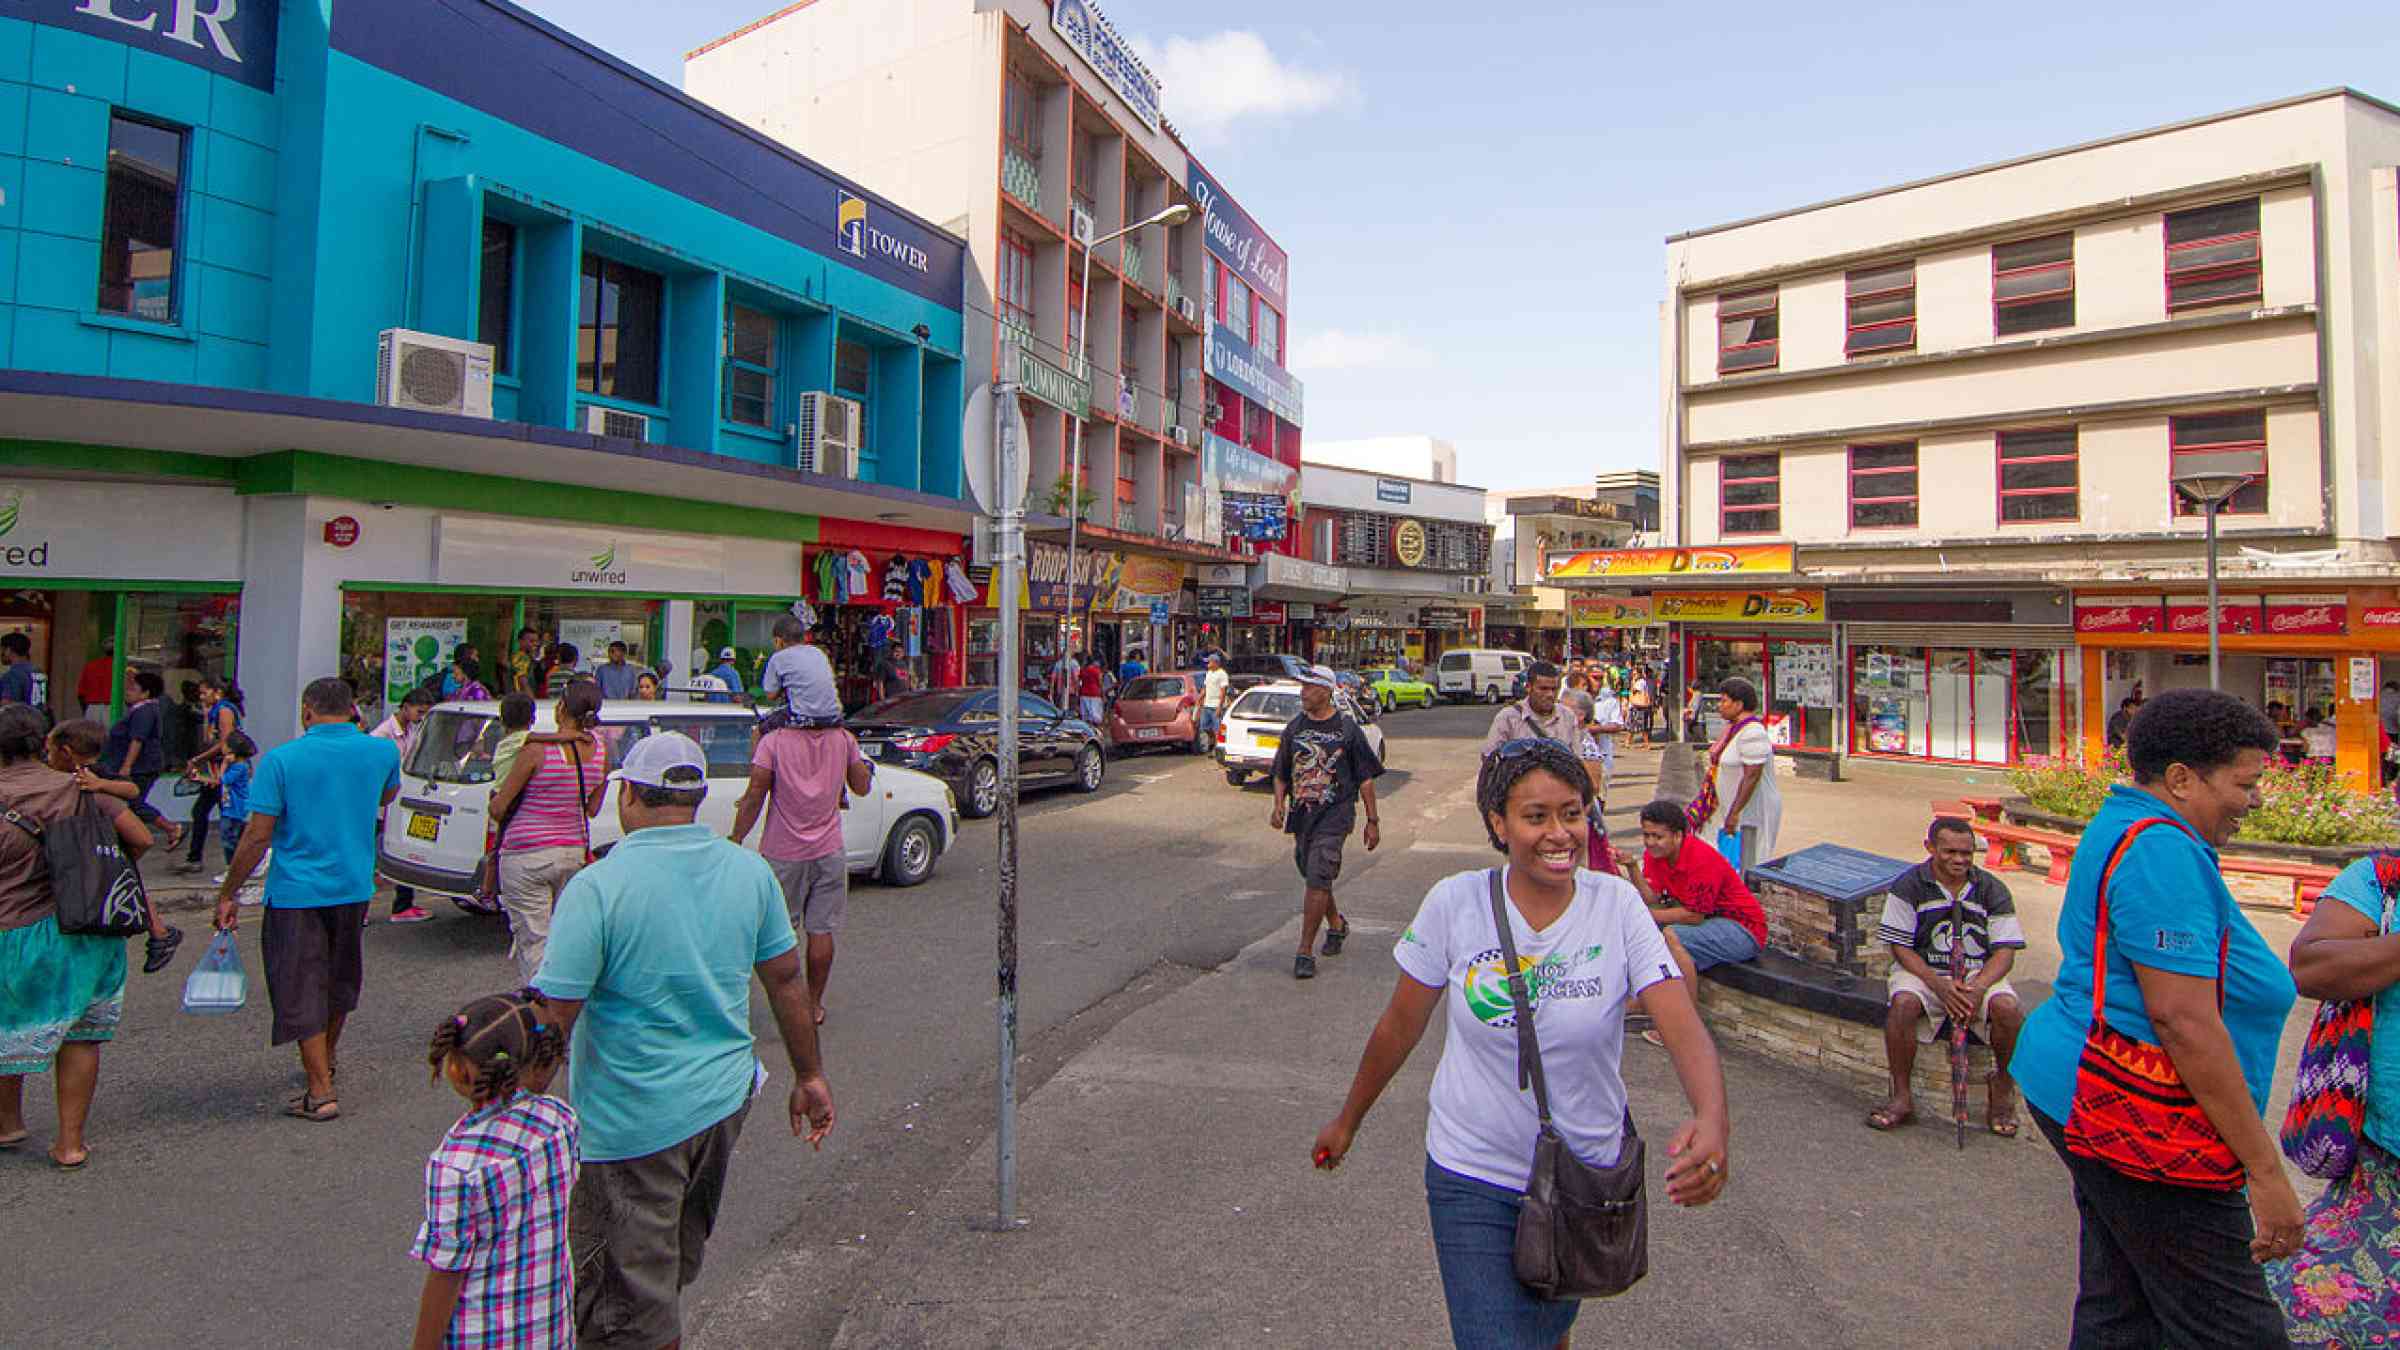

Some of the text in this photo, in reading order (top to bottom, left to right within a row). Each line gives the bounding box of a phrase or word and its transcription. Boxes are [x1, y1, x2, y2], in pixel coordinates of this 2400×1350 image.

[868, 225, 929, 273] TOWER
[1021, 355, 1080, 412] CUMMING
[571, 568, 627, 585] unwired
[1030, 548, 1092, 587] ROOPSH
[2079, 606, 2132, 631] Coca-Cola
[2173, 606, 2228, 631] Coca-Cla
[2271, 606, 2332, 632] Coca-Cola
